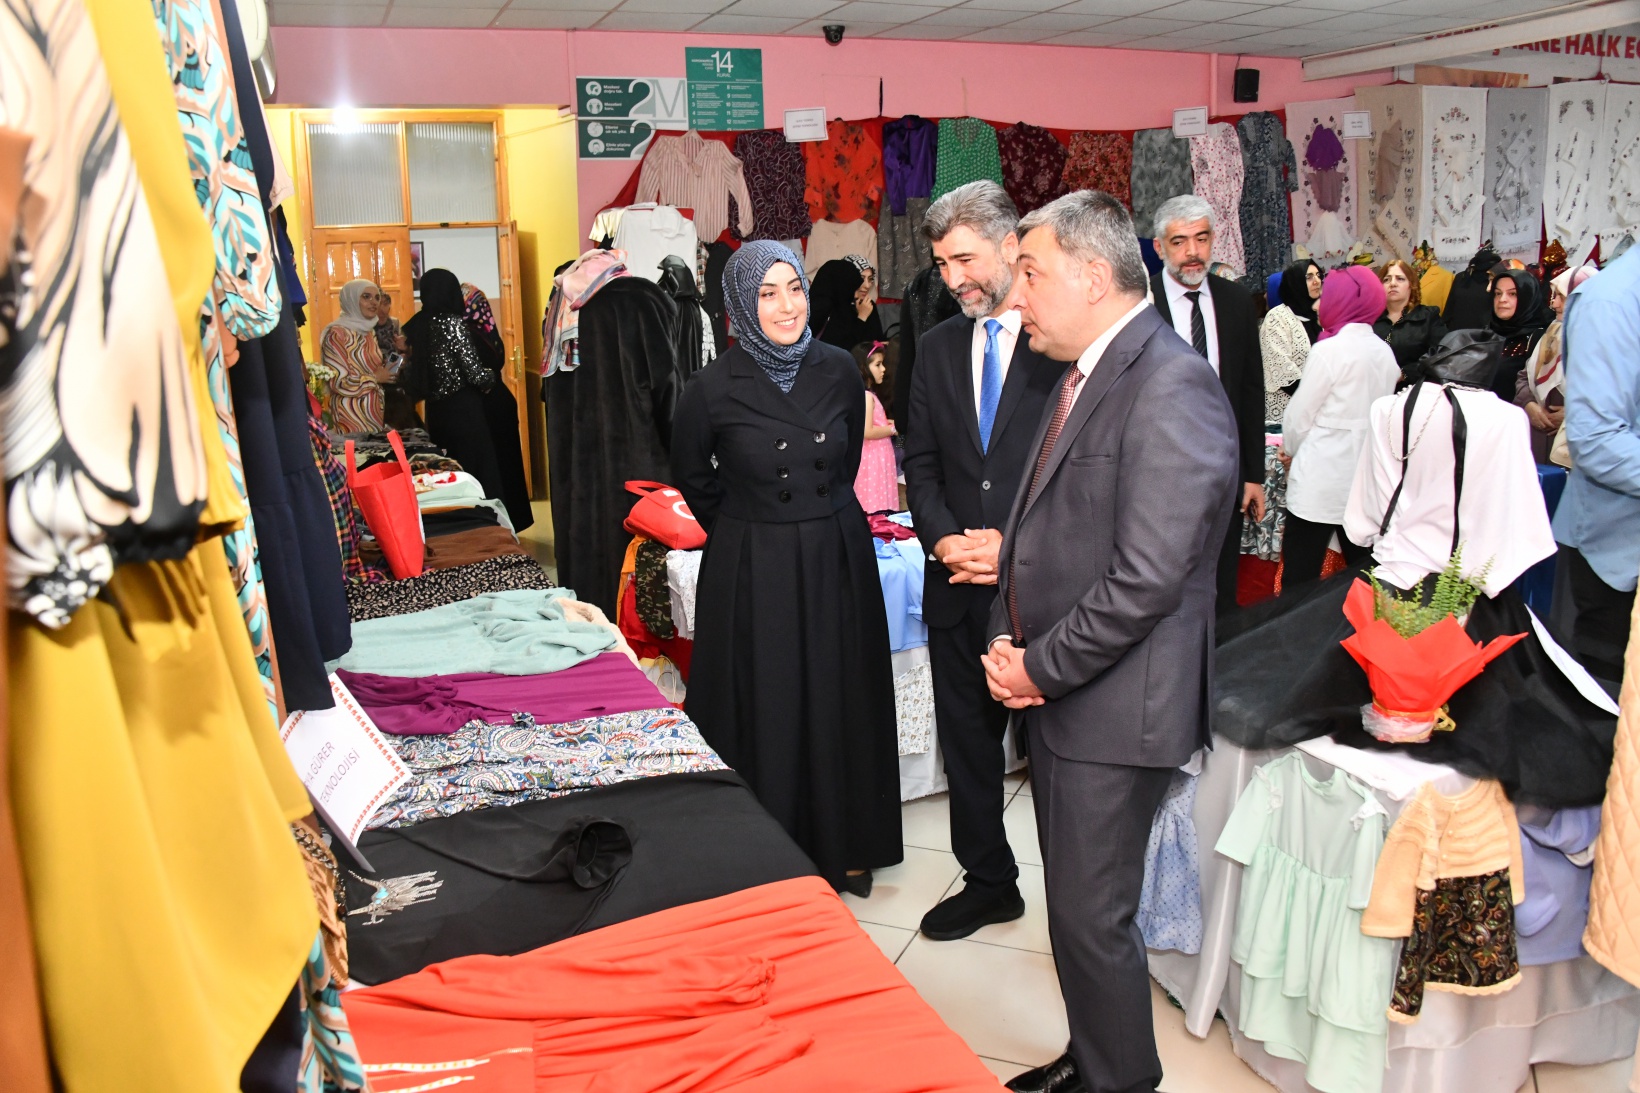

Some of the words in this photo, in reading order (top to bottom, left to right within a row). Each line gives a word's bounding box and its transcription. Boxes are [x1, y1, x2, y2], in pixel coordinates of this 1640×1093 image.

[1565, 33, 1621, 58] HALK
[711, 50, 734, 73] 14
[310, 741, 336, 775] GÜRER
